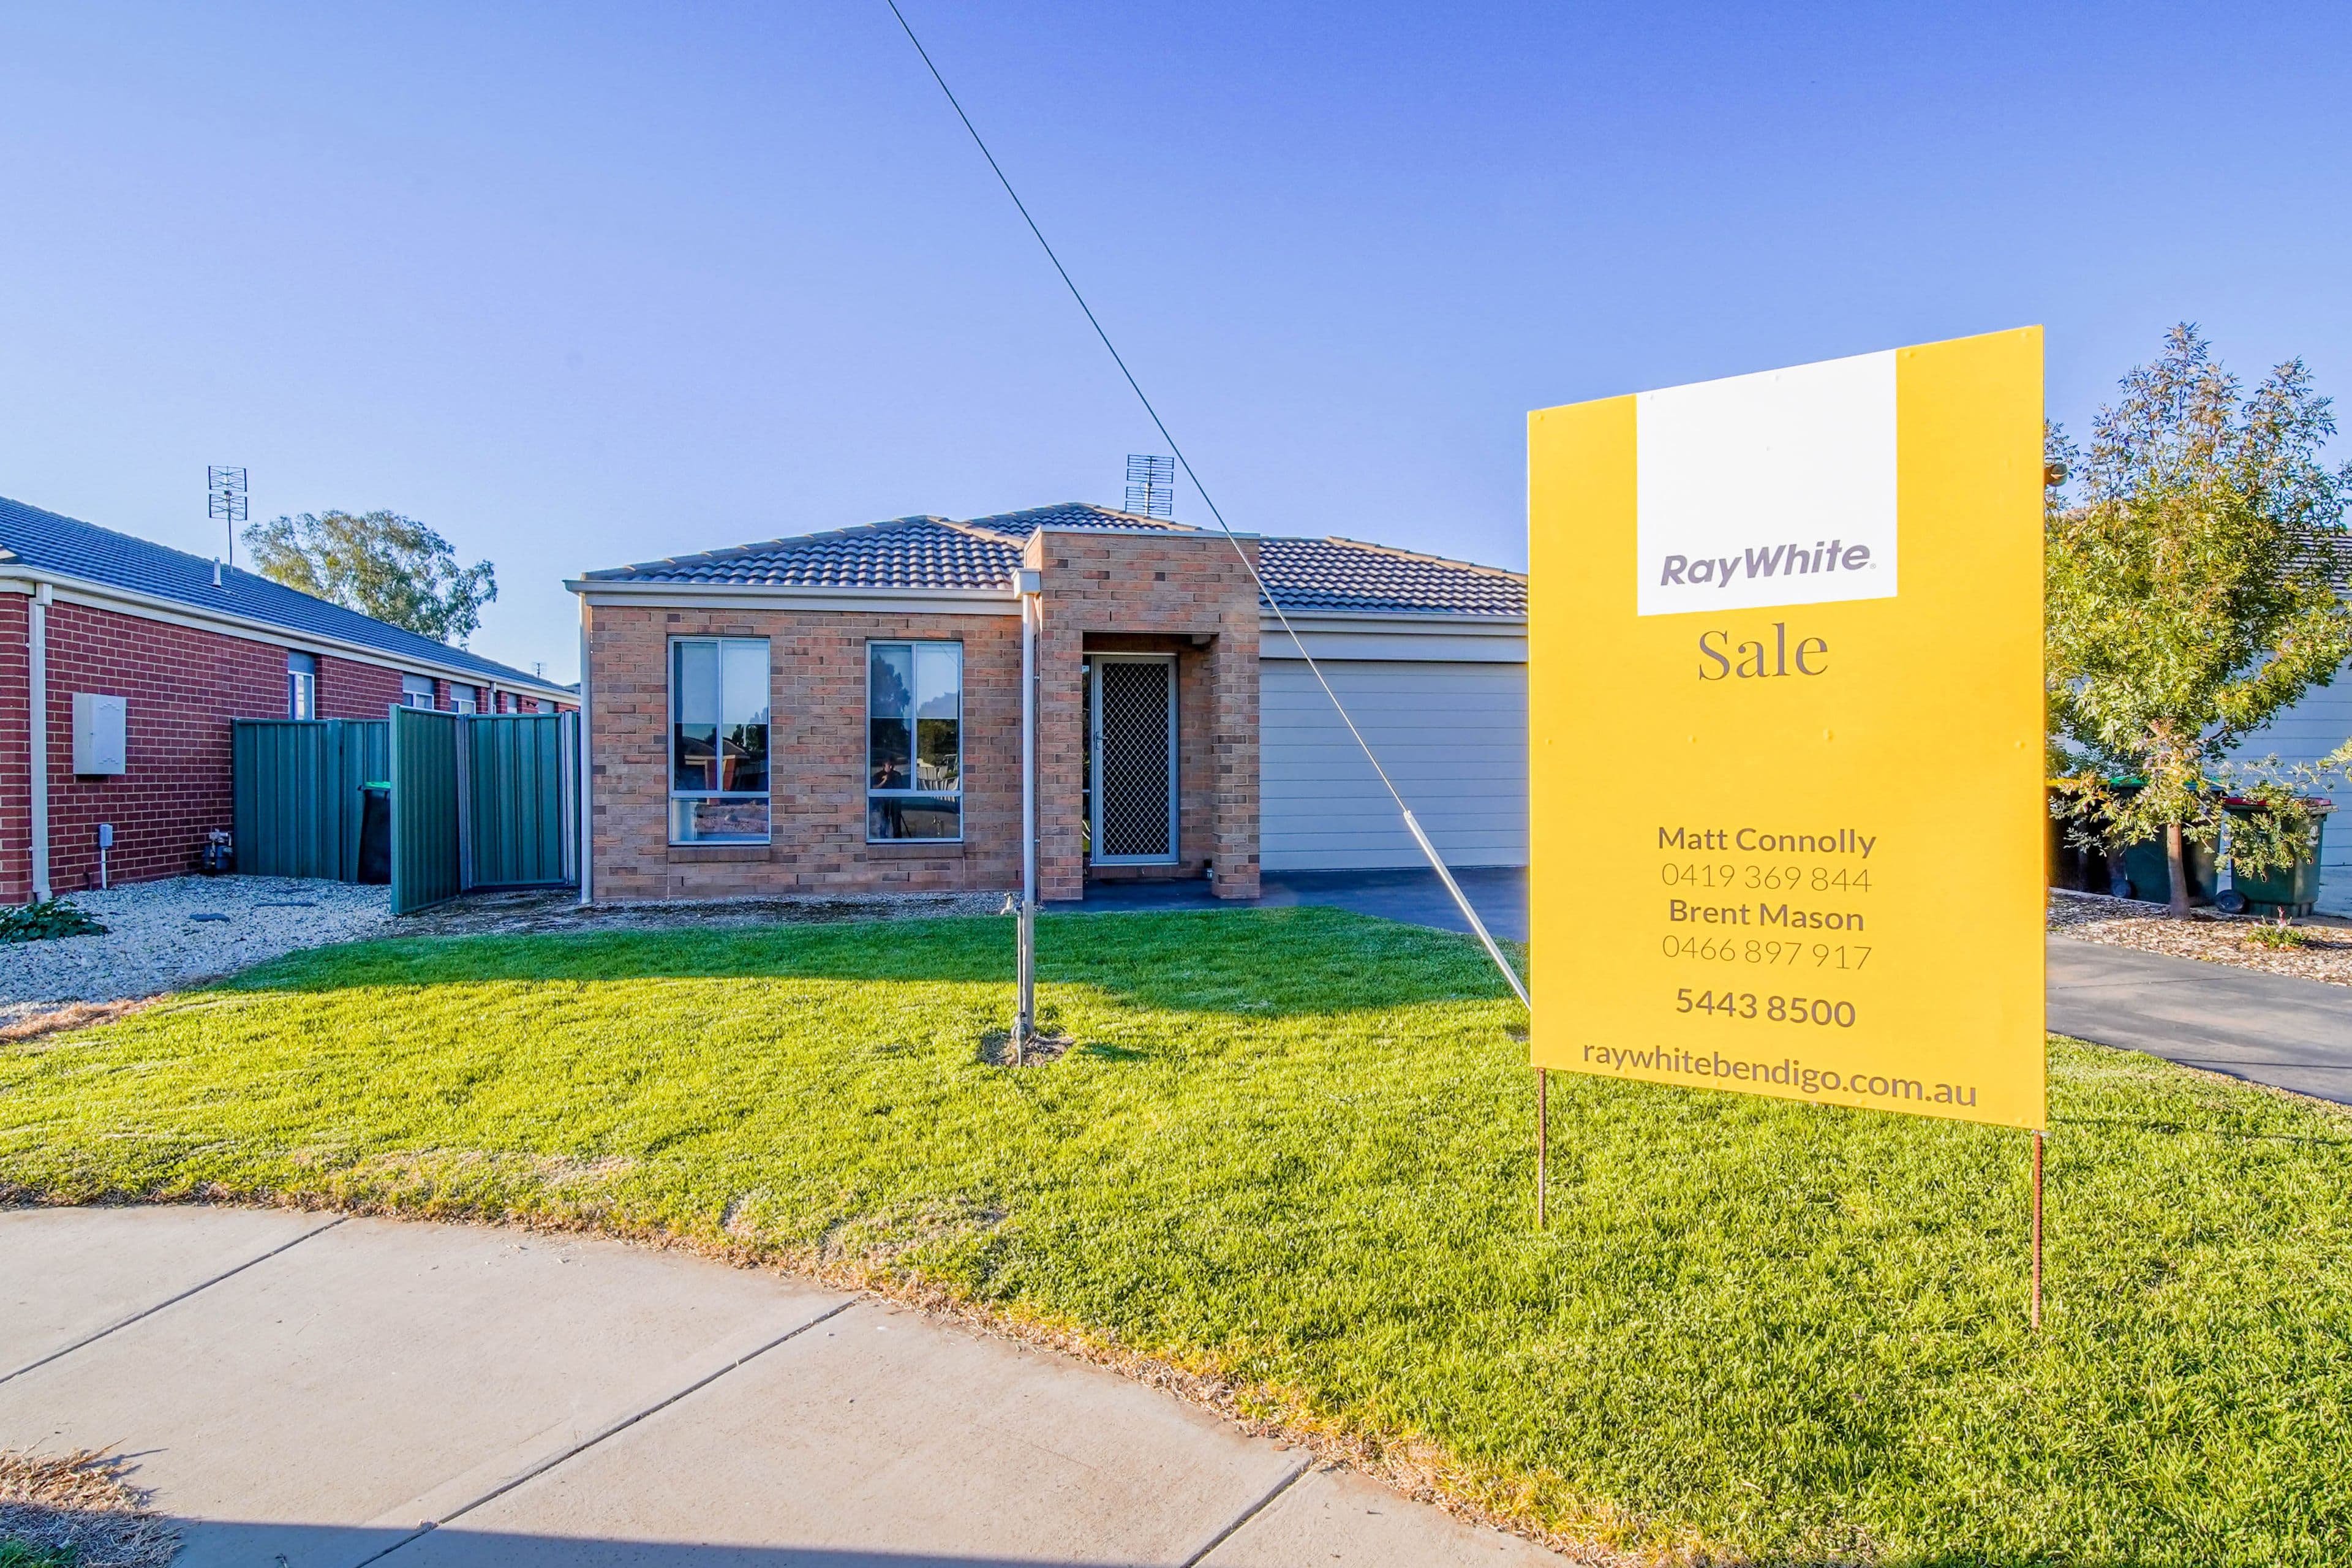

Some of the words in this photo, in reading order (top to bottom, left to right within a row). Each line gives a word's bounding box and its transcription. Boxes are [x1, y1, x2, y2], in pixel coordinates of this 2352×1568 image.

[1700, 622, 1828, 680] Sale
[1659, 827, 1727, 850] Matt
[1736, 827, 1876, 859] Connolly
[1662, 864, 1735, 887] 0419
[1745, 865, 1801, 890] 369
[1811, 868, 1871, 892] 844
[1670, 899, 1750, 925] Brent
[1760, 903, 1864, 931] Mason
[1662, 935, 1736, 961] 0466
[1745, 940, 1802, 965] 897
[1812, 944, 1872, 969] 917
[1676, 988, 1757, 1019] 5443
[1767, 995, 1856, 1028] 8500
[1584, 1044, 1976, 1107] raywhitebendigo.com.au
